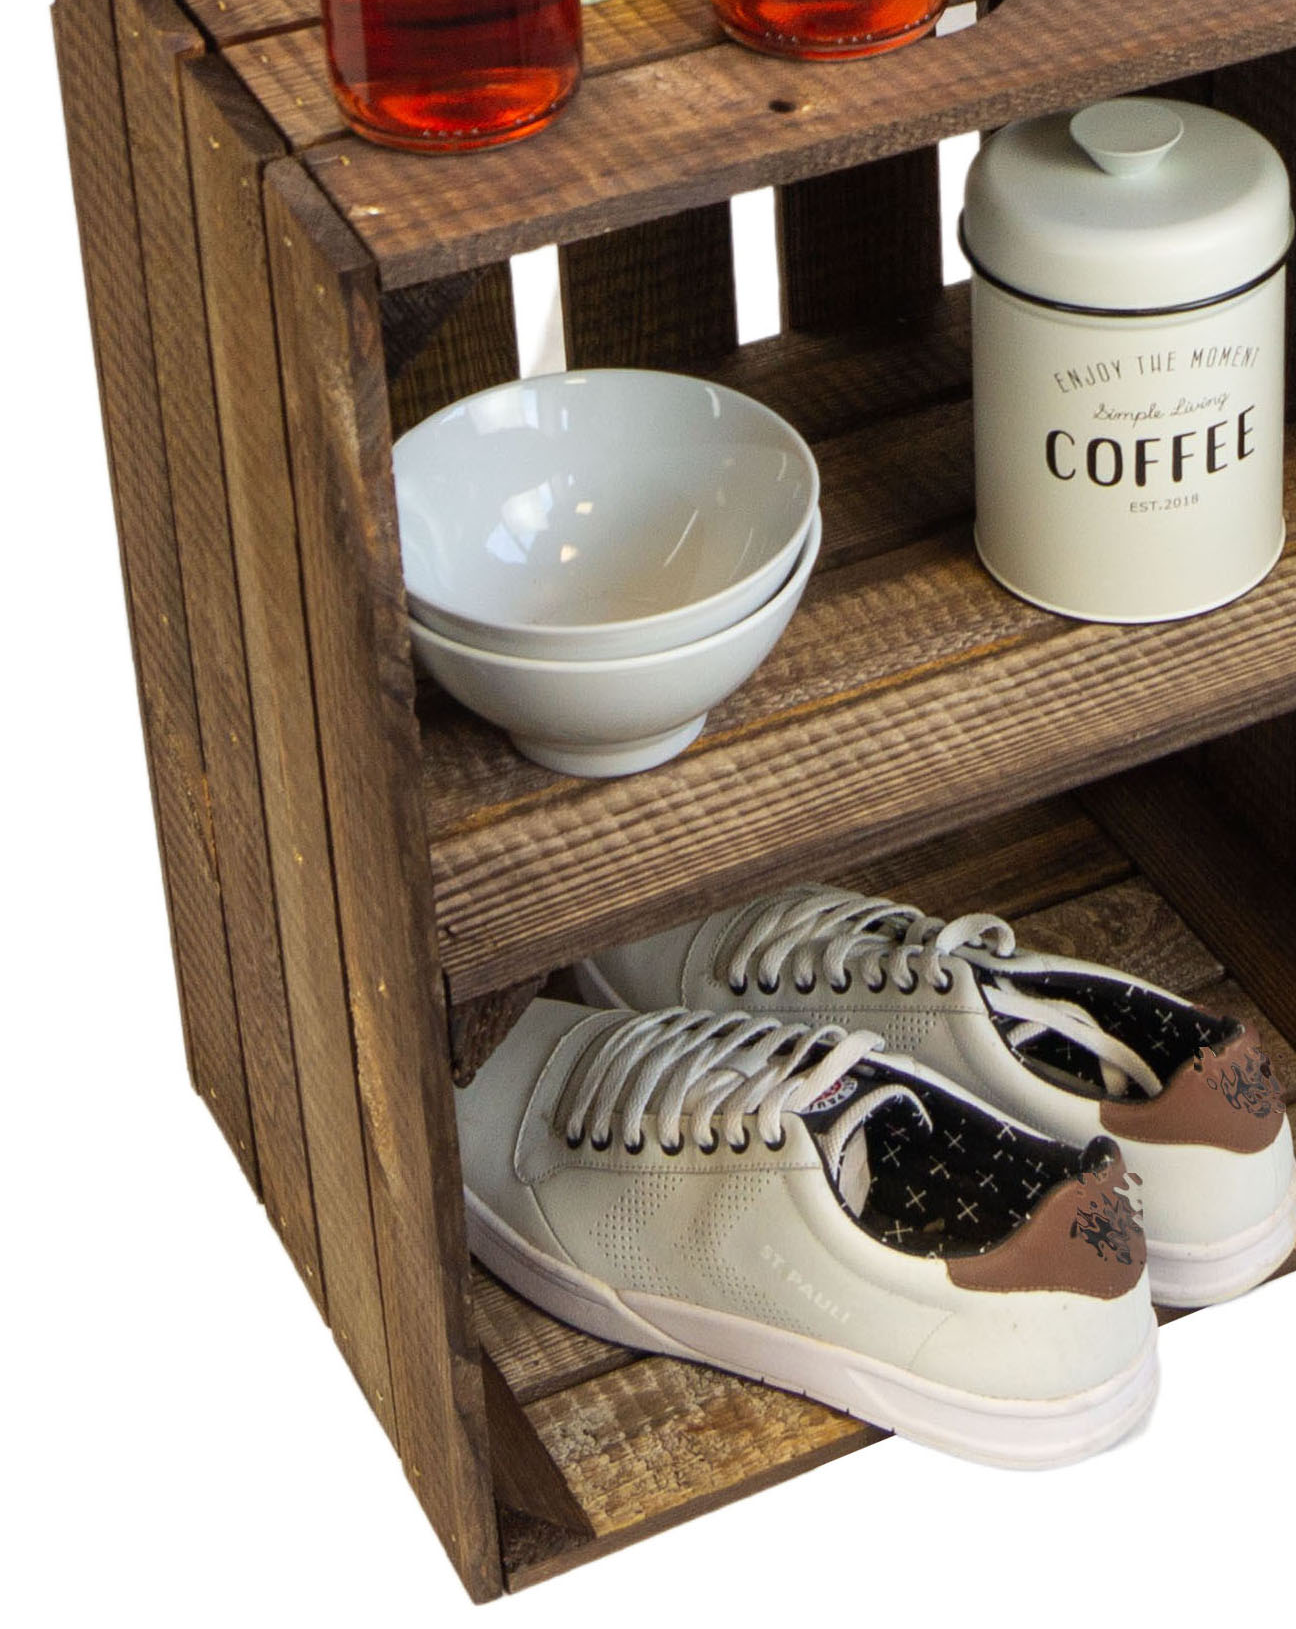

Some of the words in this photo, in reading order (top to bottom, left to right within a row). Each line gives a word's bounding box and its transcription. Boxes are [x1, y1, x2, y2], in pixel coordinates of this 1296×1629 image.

[1054, 359, 1122, 394] ENJOY
[1137, 350, 1176, 375] THE
[1190, 345, 1261, 370] MOMENT
[1092, 402, 1164, 429] Simple
[1169, 391, 1231, 418] Living
[1045, 404, 1256, 488] COFFEE
[1129, 493, 1200, 514] EST.2018
[786, 1268, 851, 1325] PAULI
